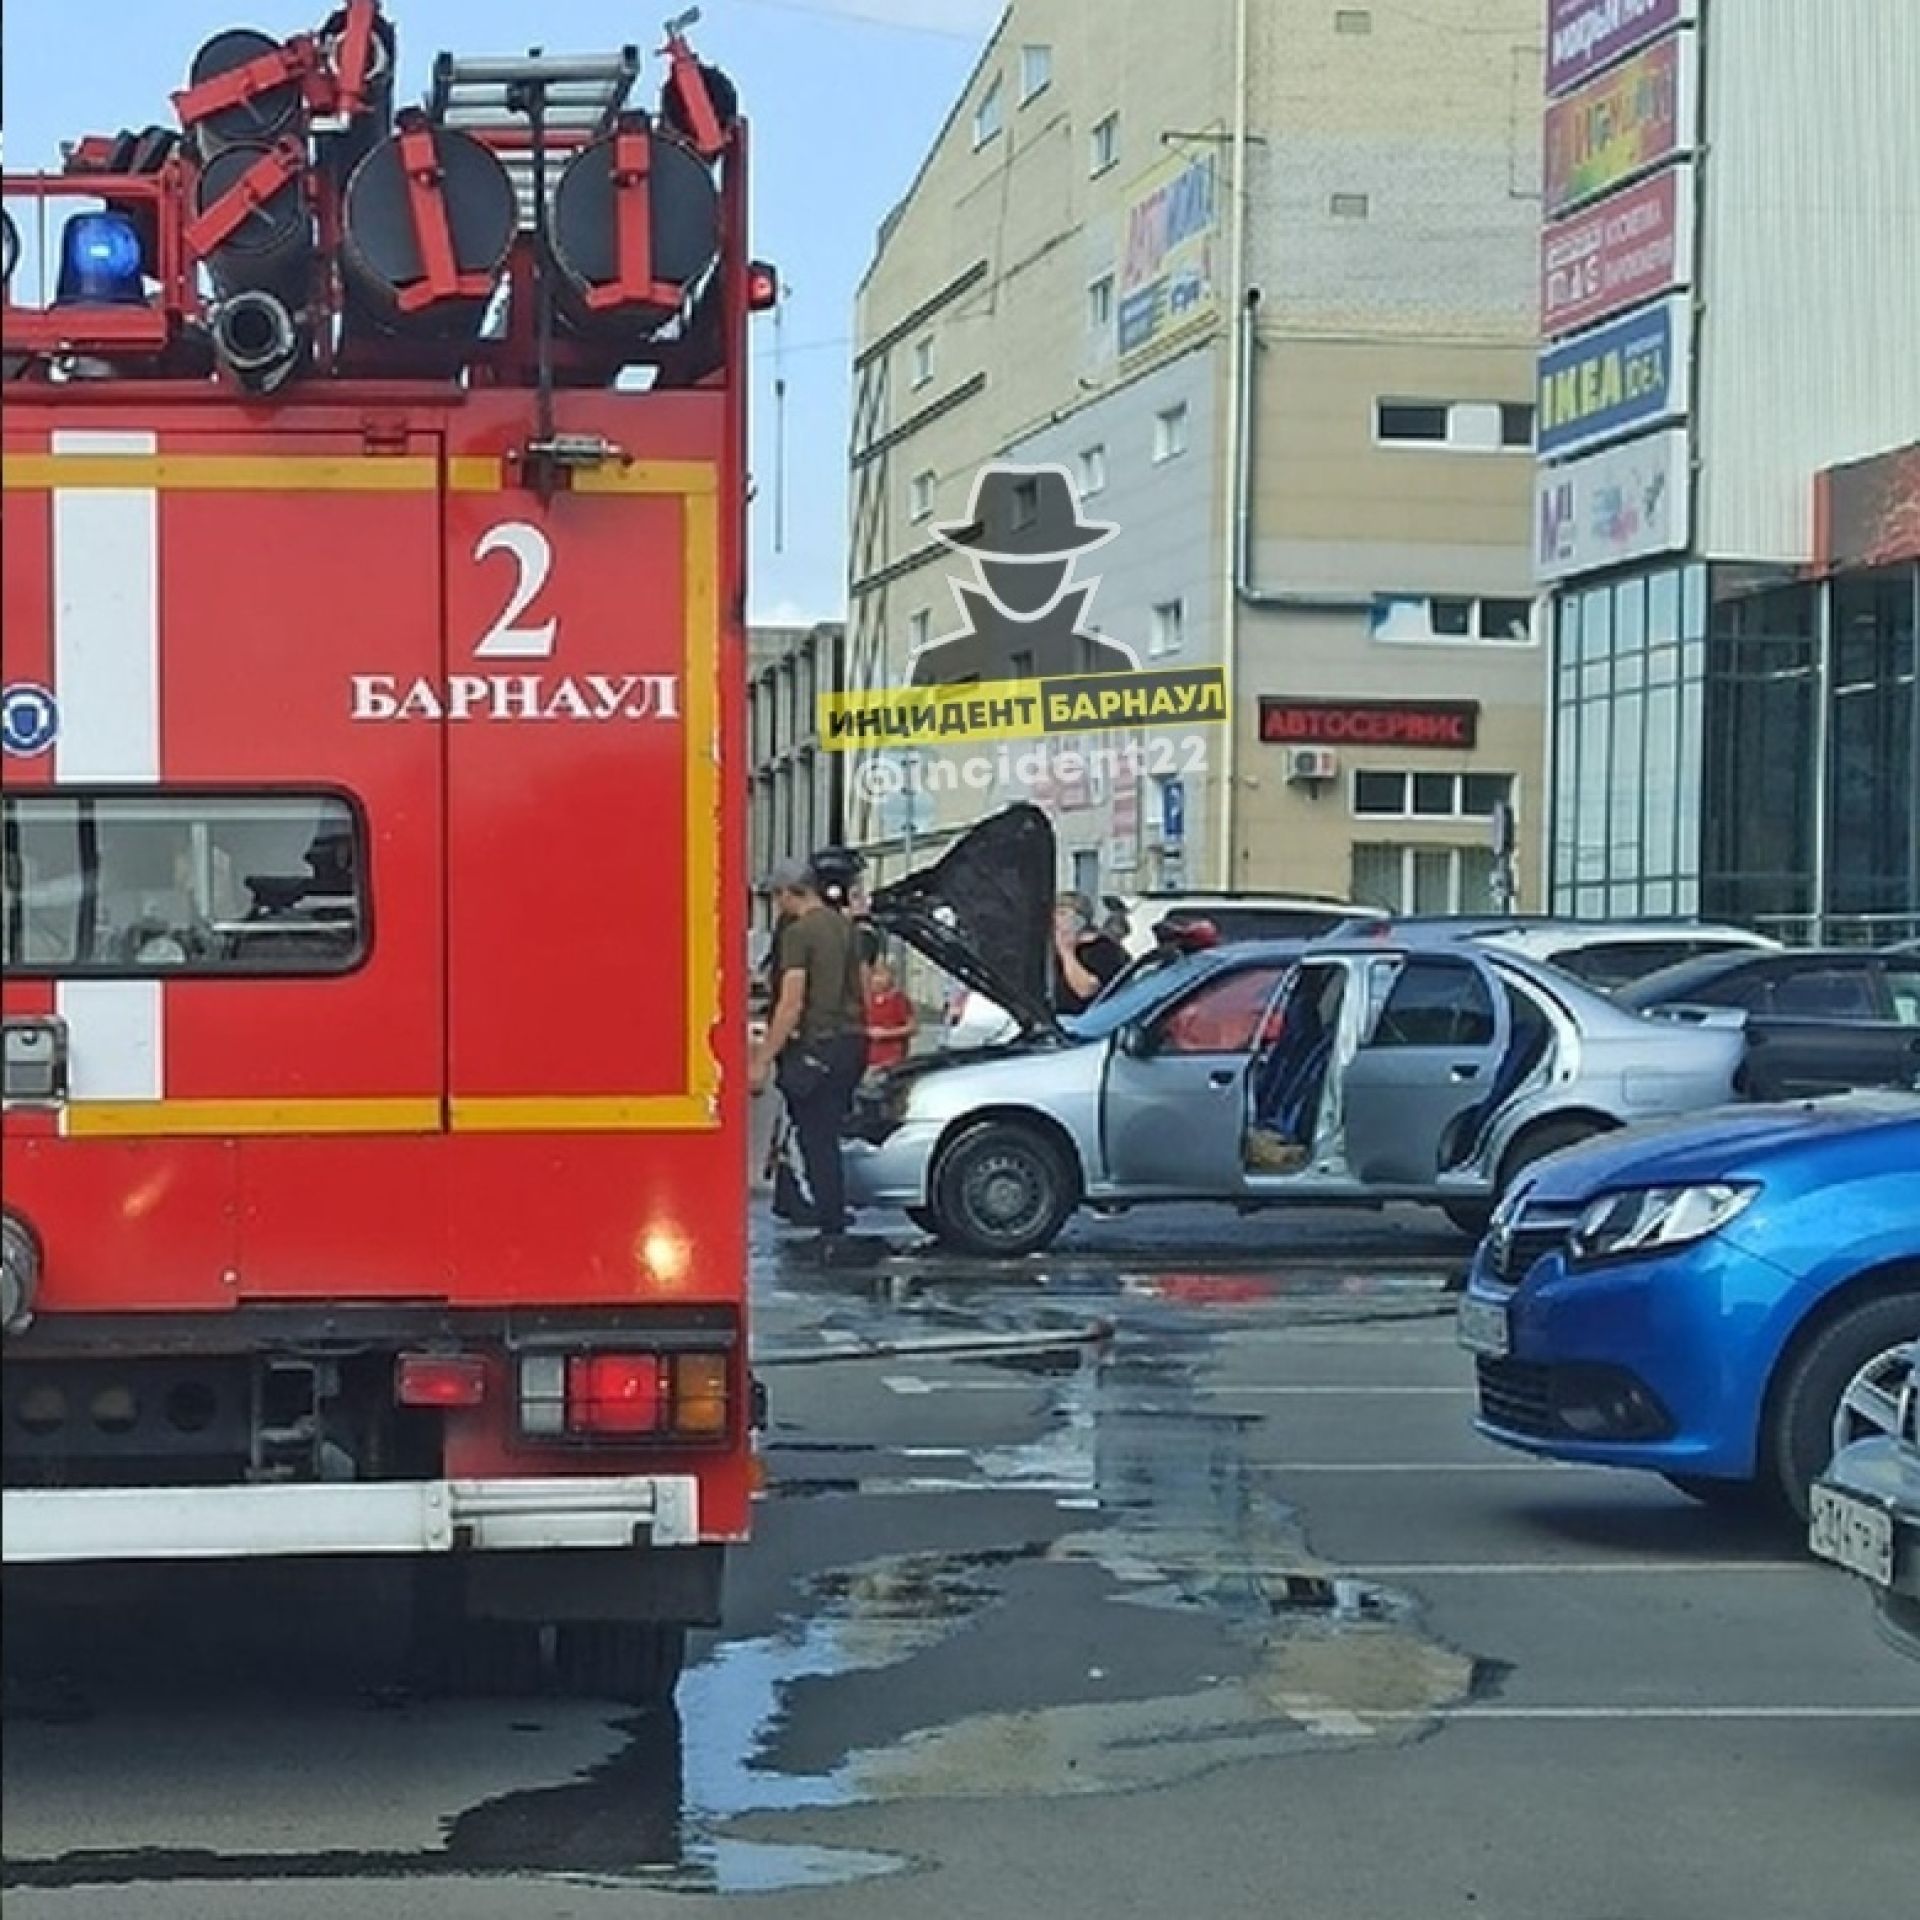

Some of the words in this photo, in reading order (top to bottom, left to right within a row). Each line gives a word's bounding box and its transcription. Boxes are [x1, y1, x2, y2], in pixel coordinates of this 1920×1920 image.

[1542, 350, 1622, 430] IKEA
[473, 522, 557, 656] 2
[351, 675, 679, 719] БАРНАУЛ
[1266, 709, 1465, 741] АВТОСЕРВИС
